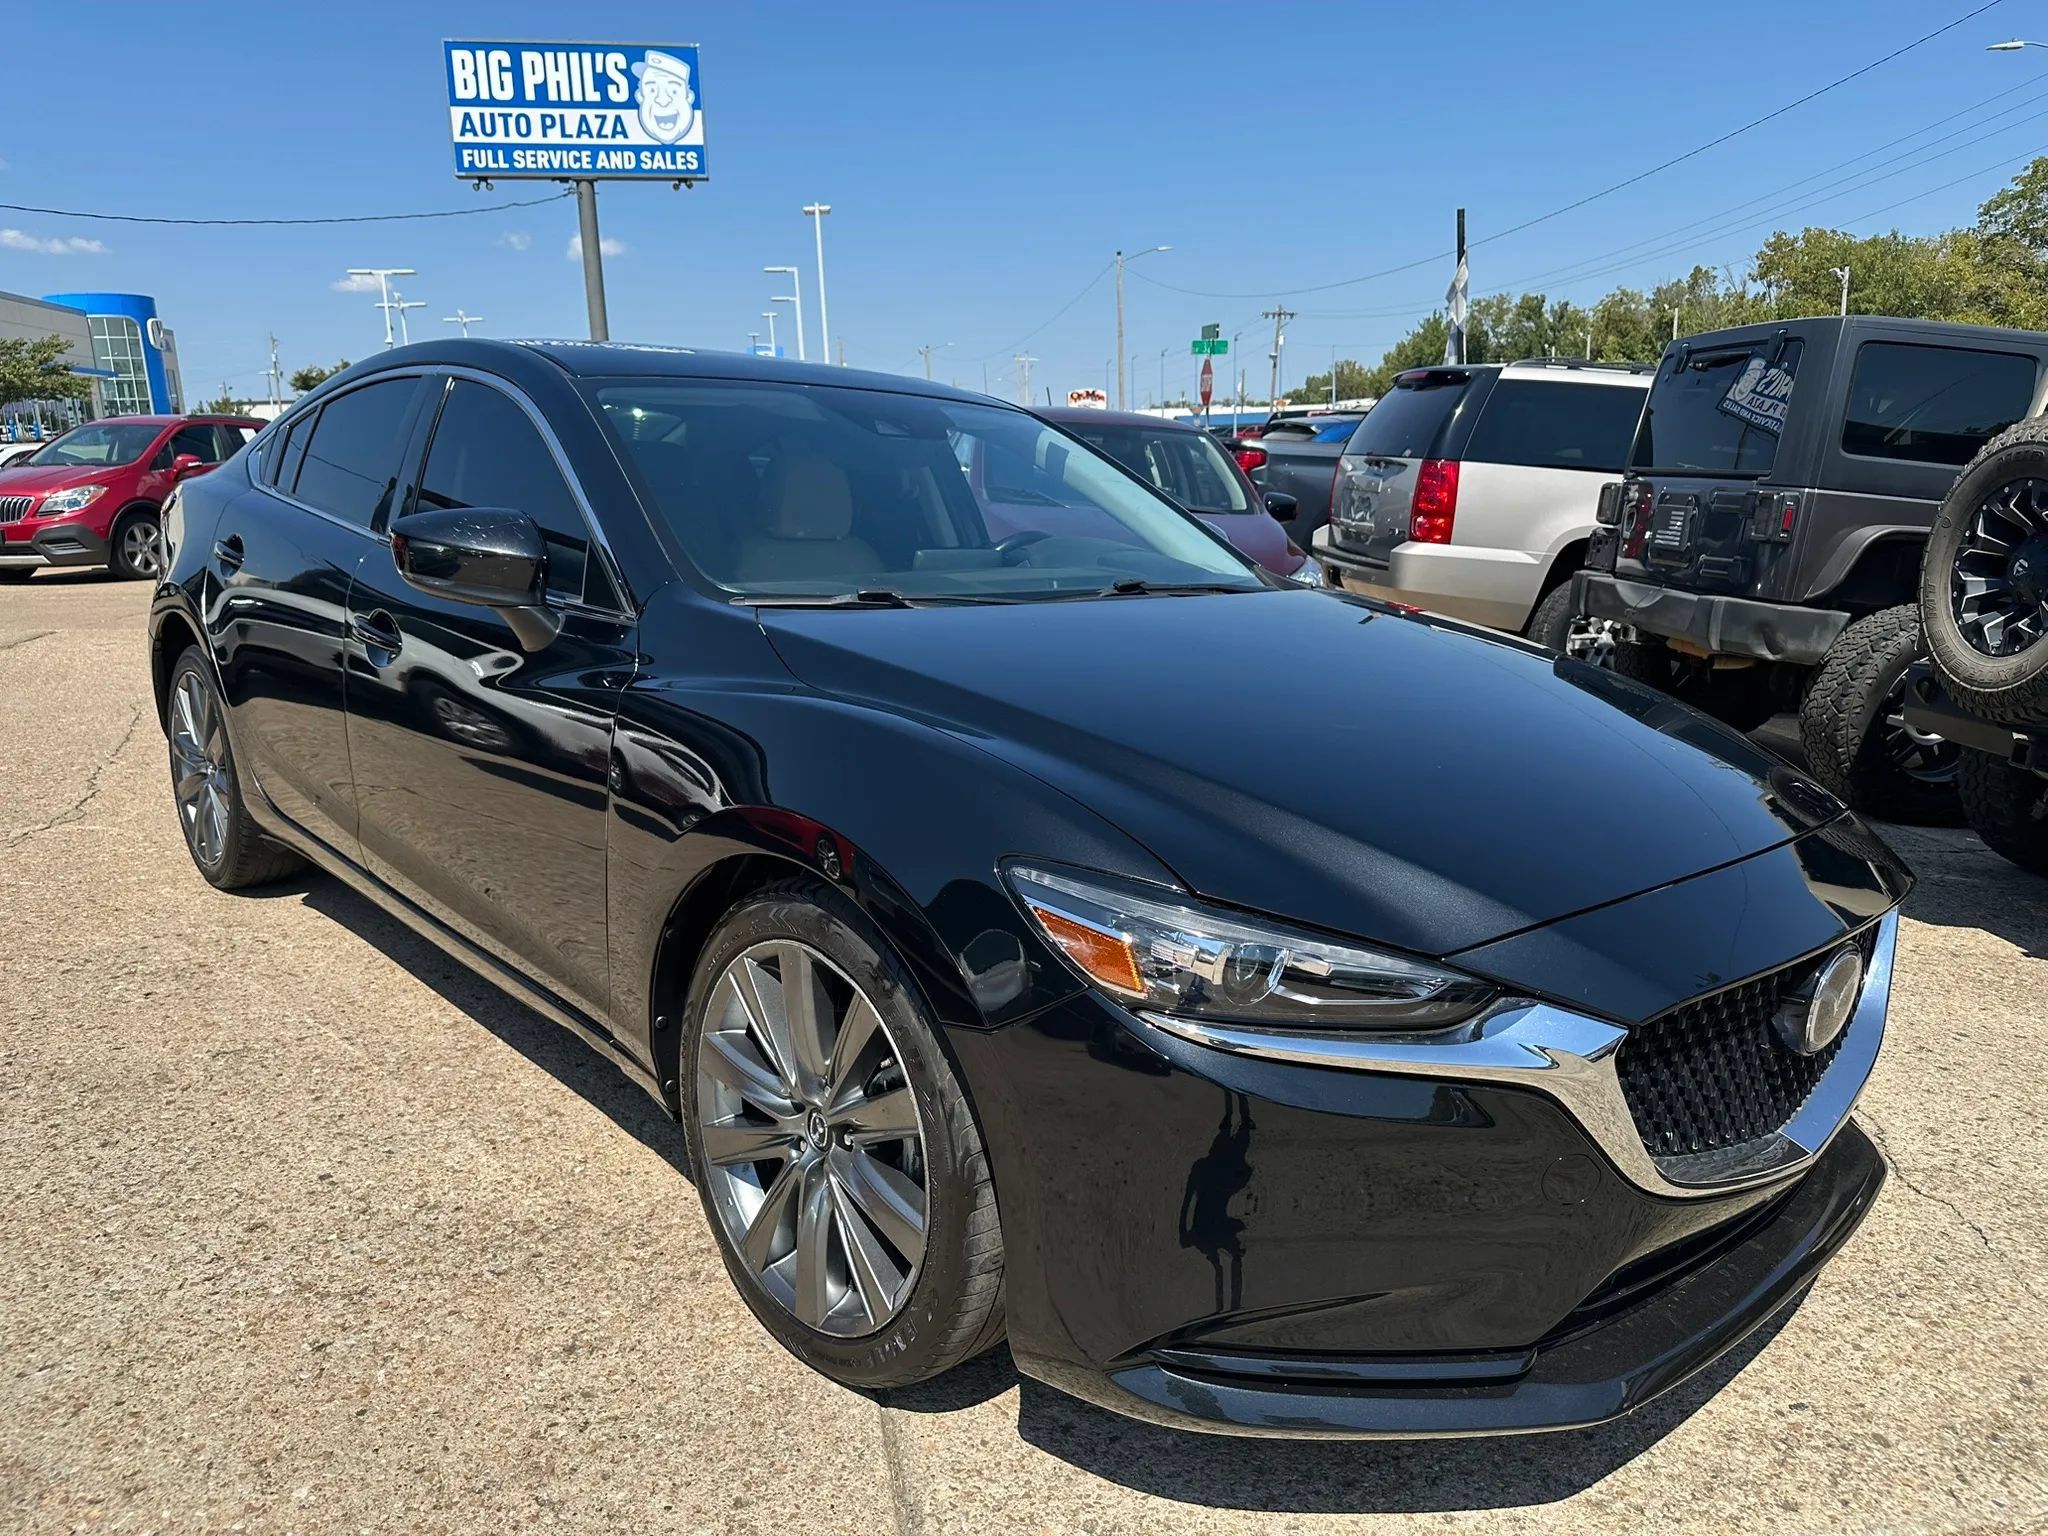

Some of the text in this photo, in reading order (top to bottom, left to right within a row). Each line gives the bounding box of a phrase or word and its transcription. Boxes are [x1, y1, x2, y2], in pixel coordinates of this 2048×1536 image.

[451, 49, 629, 103] BIG PHIL'S
[459, 112, 629, 139] AUTO PLAZA
[462, 148, 699, 170] FULL SERVICE AND SALES
